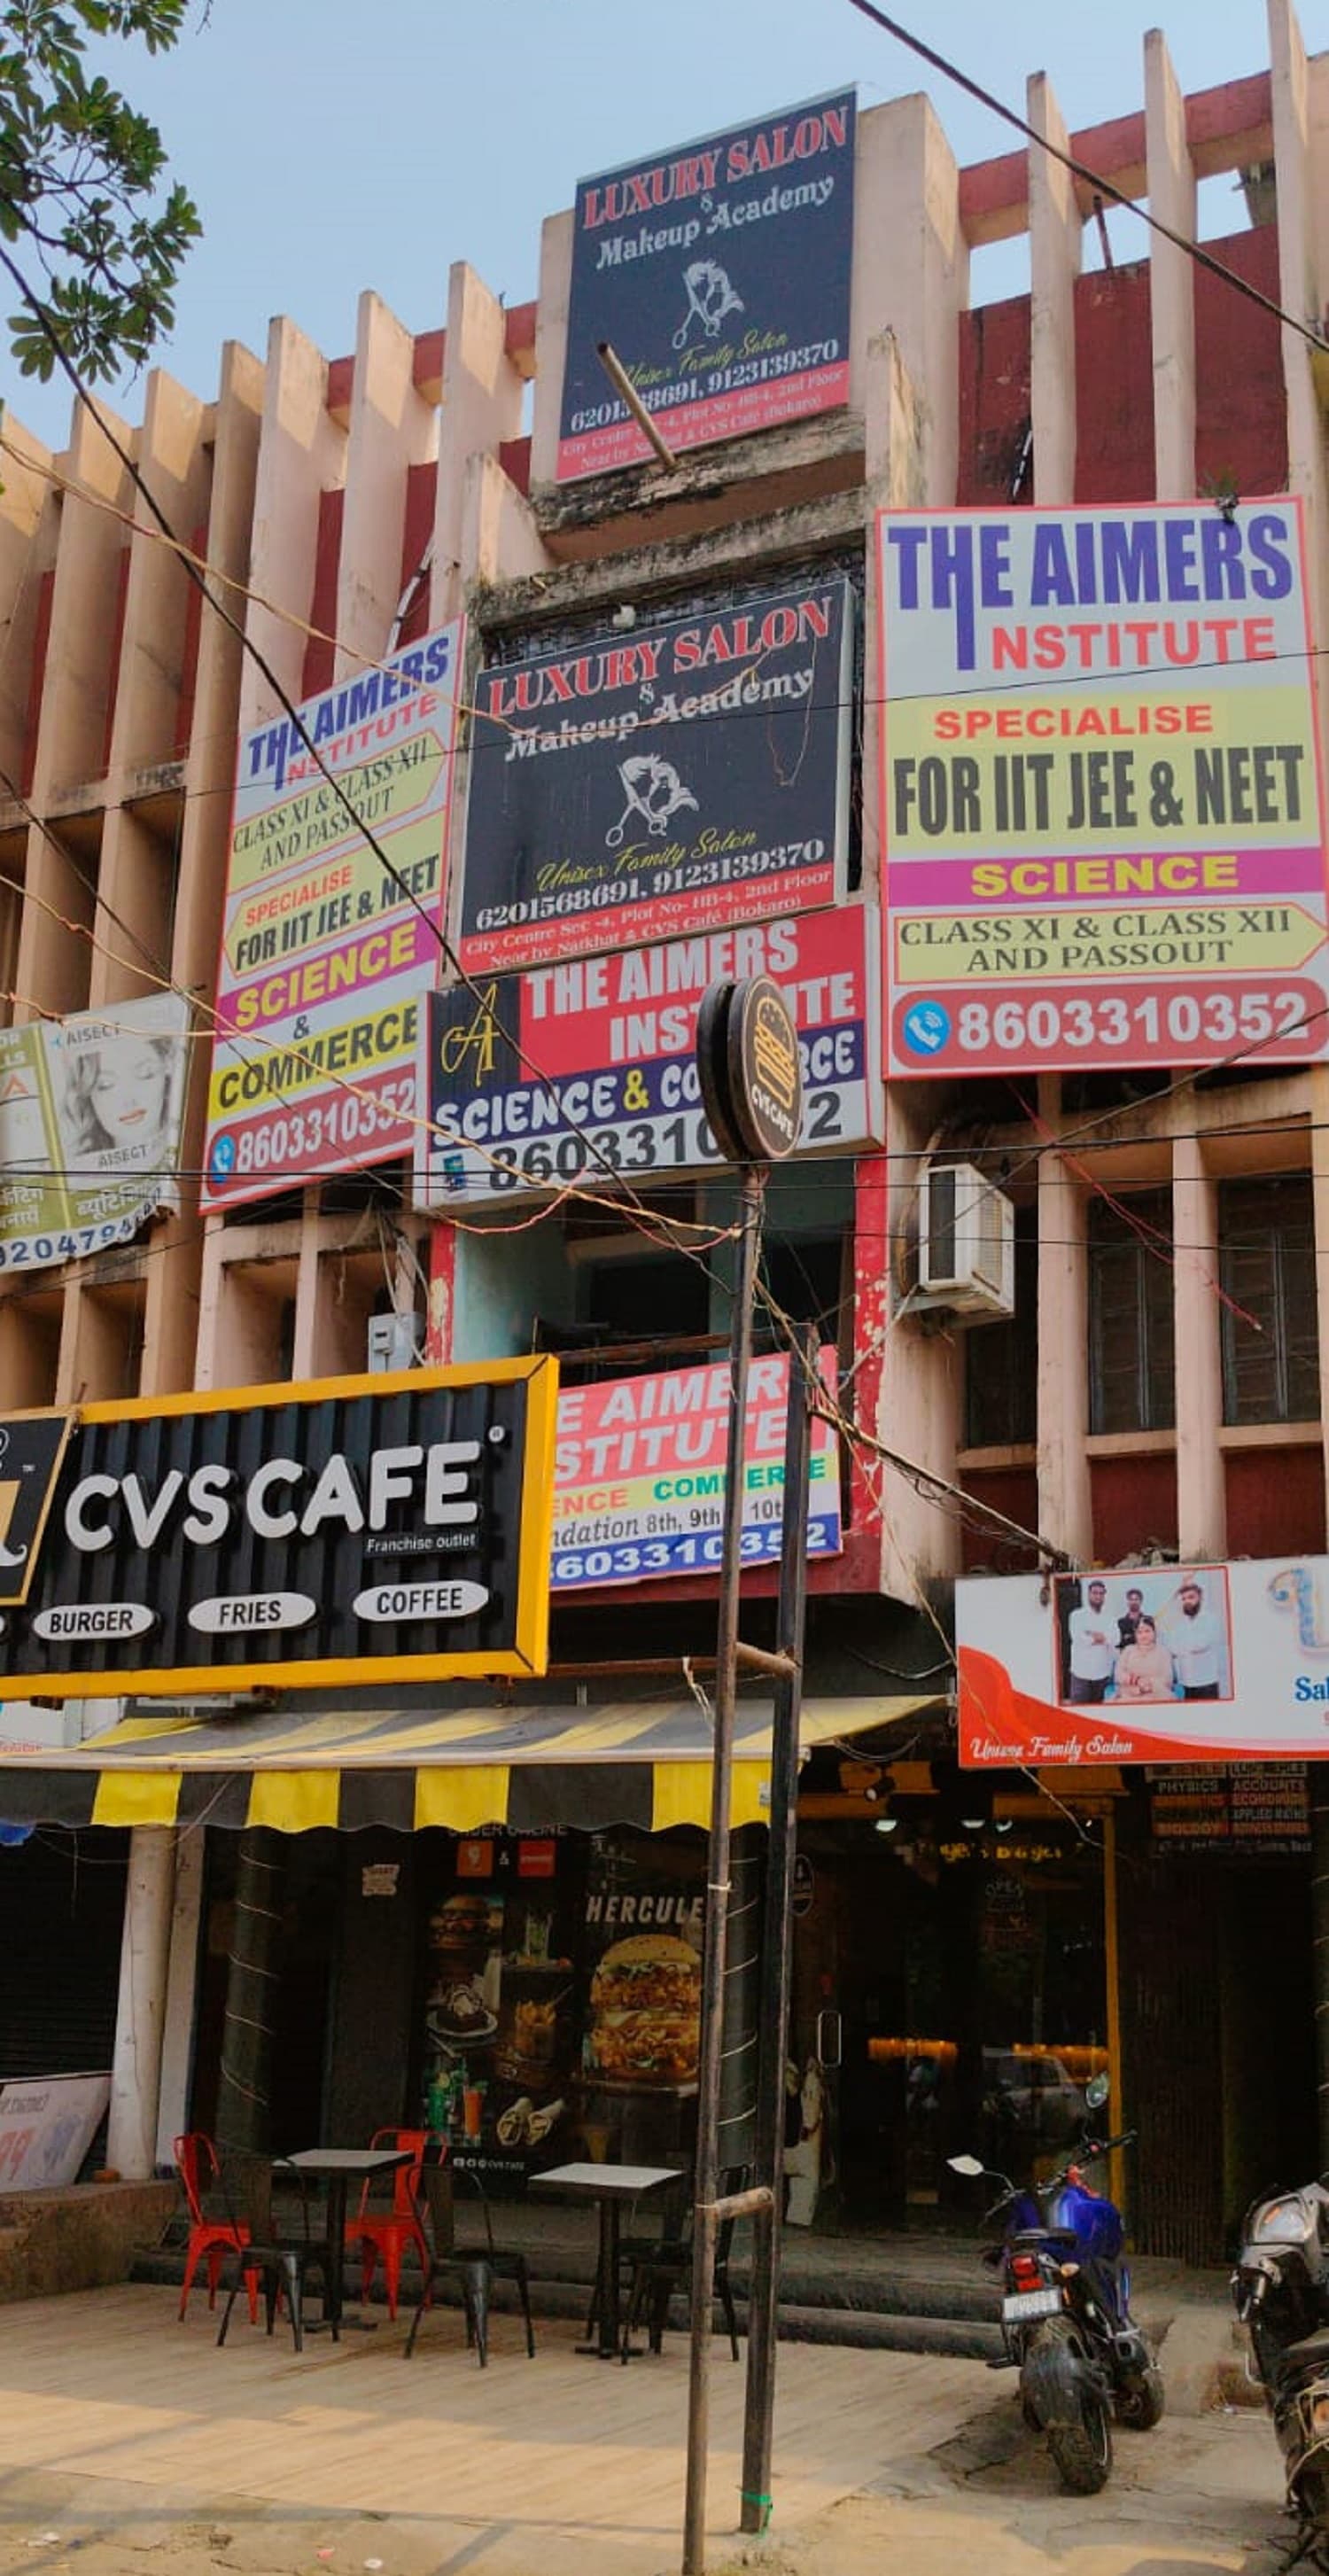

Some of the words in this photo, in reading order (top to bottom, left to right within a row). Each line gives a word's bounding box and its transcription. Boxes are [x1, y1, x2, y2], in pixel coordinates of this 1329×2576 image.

[583, 148, 723, 230] LUXURY
[727, 105, 848, 183] SALON
[596, 218, 700, 269] Makeup
[707, 175, 835, 237] Academy
[709, 339, 838, 393] 9123139370
[737, 329, 788, 359] Salon
[888, 525, 1014, 670] THE
[1030, 515, 1294, 606] AIMERS
[488, 637, 665, 720] LUXURY
[673, 596, 833, 673] SALON
[248, 712, 306, 790] THE
[313, 636, 449, 744] AIMERS
[505, 710, 639, 762] Makeup
[653, 667, 815, 723] Academy
[934, 704, 1213, 739] SPECIALISE
[232, 808, 286, 853] CLASS
[291, 796, 308, 823] XI
[315, 788, 329, 812] &
[335, 755, 392, 801] CLASS
[399, 737, 427, 773] XII
[893, 756, 981, 836] FOR
[994, 753, 1054, 832] IIT
[1067, 750, 1138, 829] JEE
[1150, 760, 1184, 827] &
[1193, 744, 1304, 825] NEET
[260, 831, 301, 871] AND
[307, 786, 394, 850] PASSOUT
[537, 858, 609, 891] Unisex
[614, 843, 687, 876] Family
[691, 828, 757, 858] Salon
[654, 839, 824, 894] 9123139370
[971, 855, 1240, 897] SCIENCE
[236, 928, 276, 971] FOR
[281, 910, 312, 951] IIT
[316, 893, 352, 937] JEE
[357, 890, 373, 918] &
[380, 853, 439, 911] NEET
[245, 865, 353, 927] SPECIALISE
[621, 907, 653, 924] Plot
[746, 881, 777, 899] 2nd
[784, 870, 832, 891] Floor
[491, 950, 526, 968] Near
[642, 921, 678, 938] CVS
[900, 918, 1012, 946] CLASS
[1023, 917, 1060, 940] XI
[1073, 915, 1100, 938] &
[1114, 911, 1226, 938] CLASS
[1239, 909, 1290, 934] XII
[967, 946, 1049, 973] AND
[1062, 939, 1233, 969] PASSOUT
[235, 922, 416, 1028] SCIENCE
[525, 961, 609, 1020] THE
[620, 919, 798, 1008] AIMERS
[293, 1015, 310, 1039] &
[958, 992, 1310, 1051] 8603310352
[219, 1004, 417, 1109] COMMERCE
[236, 1078, 416, 1173] 8603310352
[433, 1074, 618, 1146] SCIENCE
[623, 1070, 649, 1110] &
[98, 1145, 148, 1168] AISECT
[598, 1353, 822, 1426] AIMER
[367, 1537, 433, 1552] Franchise
[436, 1533, 476, 1549] outlet
[647, 1512, 682, 1534] 8th,
[689, 1504, 721, 1528] 9th
[750, 1498, 783, 1522] 10t
[49, 1609, 134, 1633] BURGER
[219, 1599, 282, 1625] FRIES
[377, 1588, 462, 1614] COFFEE
[1029, 1735, 1082, 1763] Family
[1086, 1733, 1132, 1755] Salon
[586, 1895, 705, 1924] HERCULE
